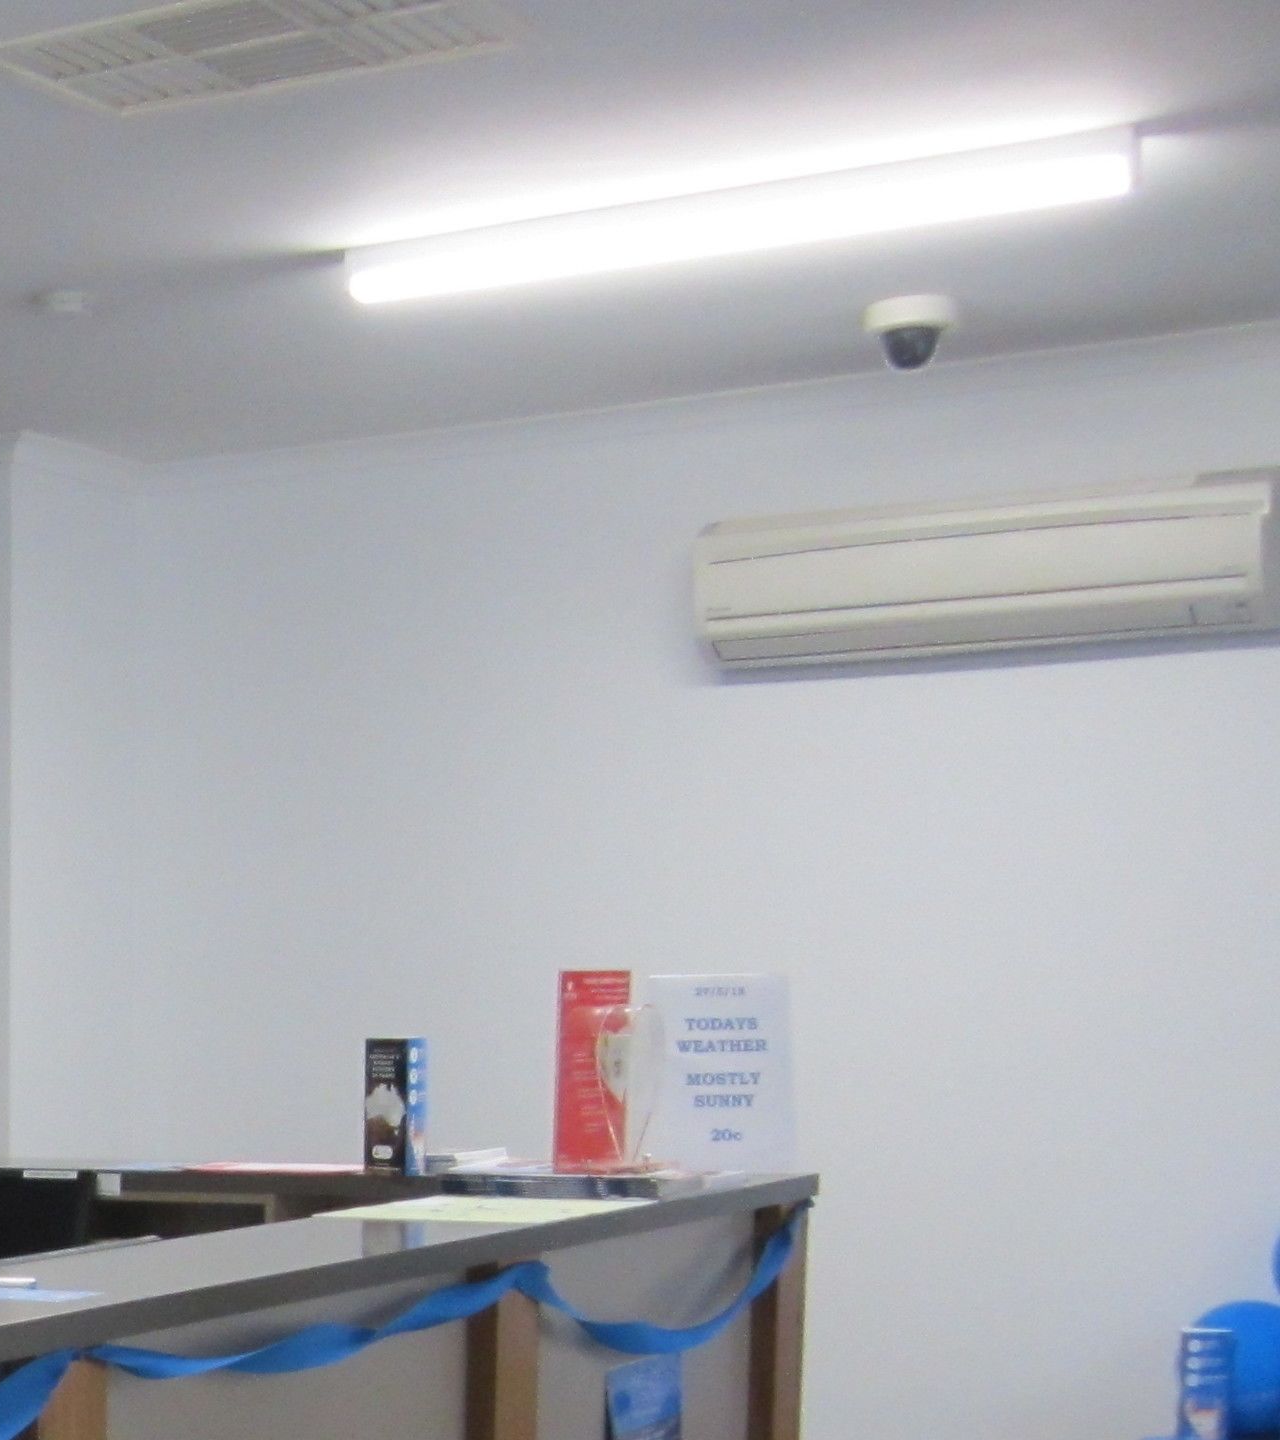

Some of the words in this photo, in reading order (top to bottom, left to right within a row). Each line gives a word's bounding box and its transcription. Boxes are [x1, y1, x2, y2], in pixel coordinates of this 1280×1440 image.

[684, 1017, 758, 1031] TODAYS
[676, 1039, 768, 1053] WEATHER
[686, 1072, 761, 1086] MOSTLY
[694, 1094, 754, 1108] SUNNY
